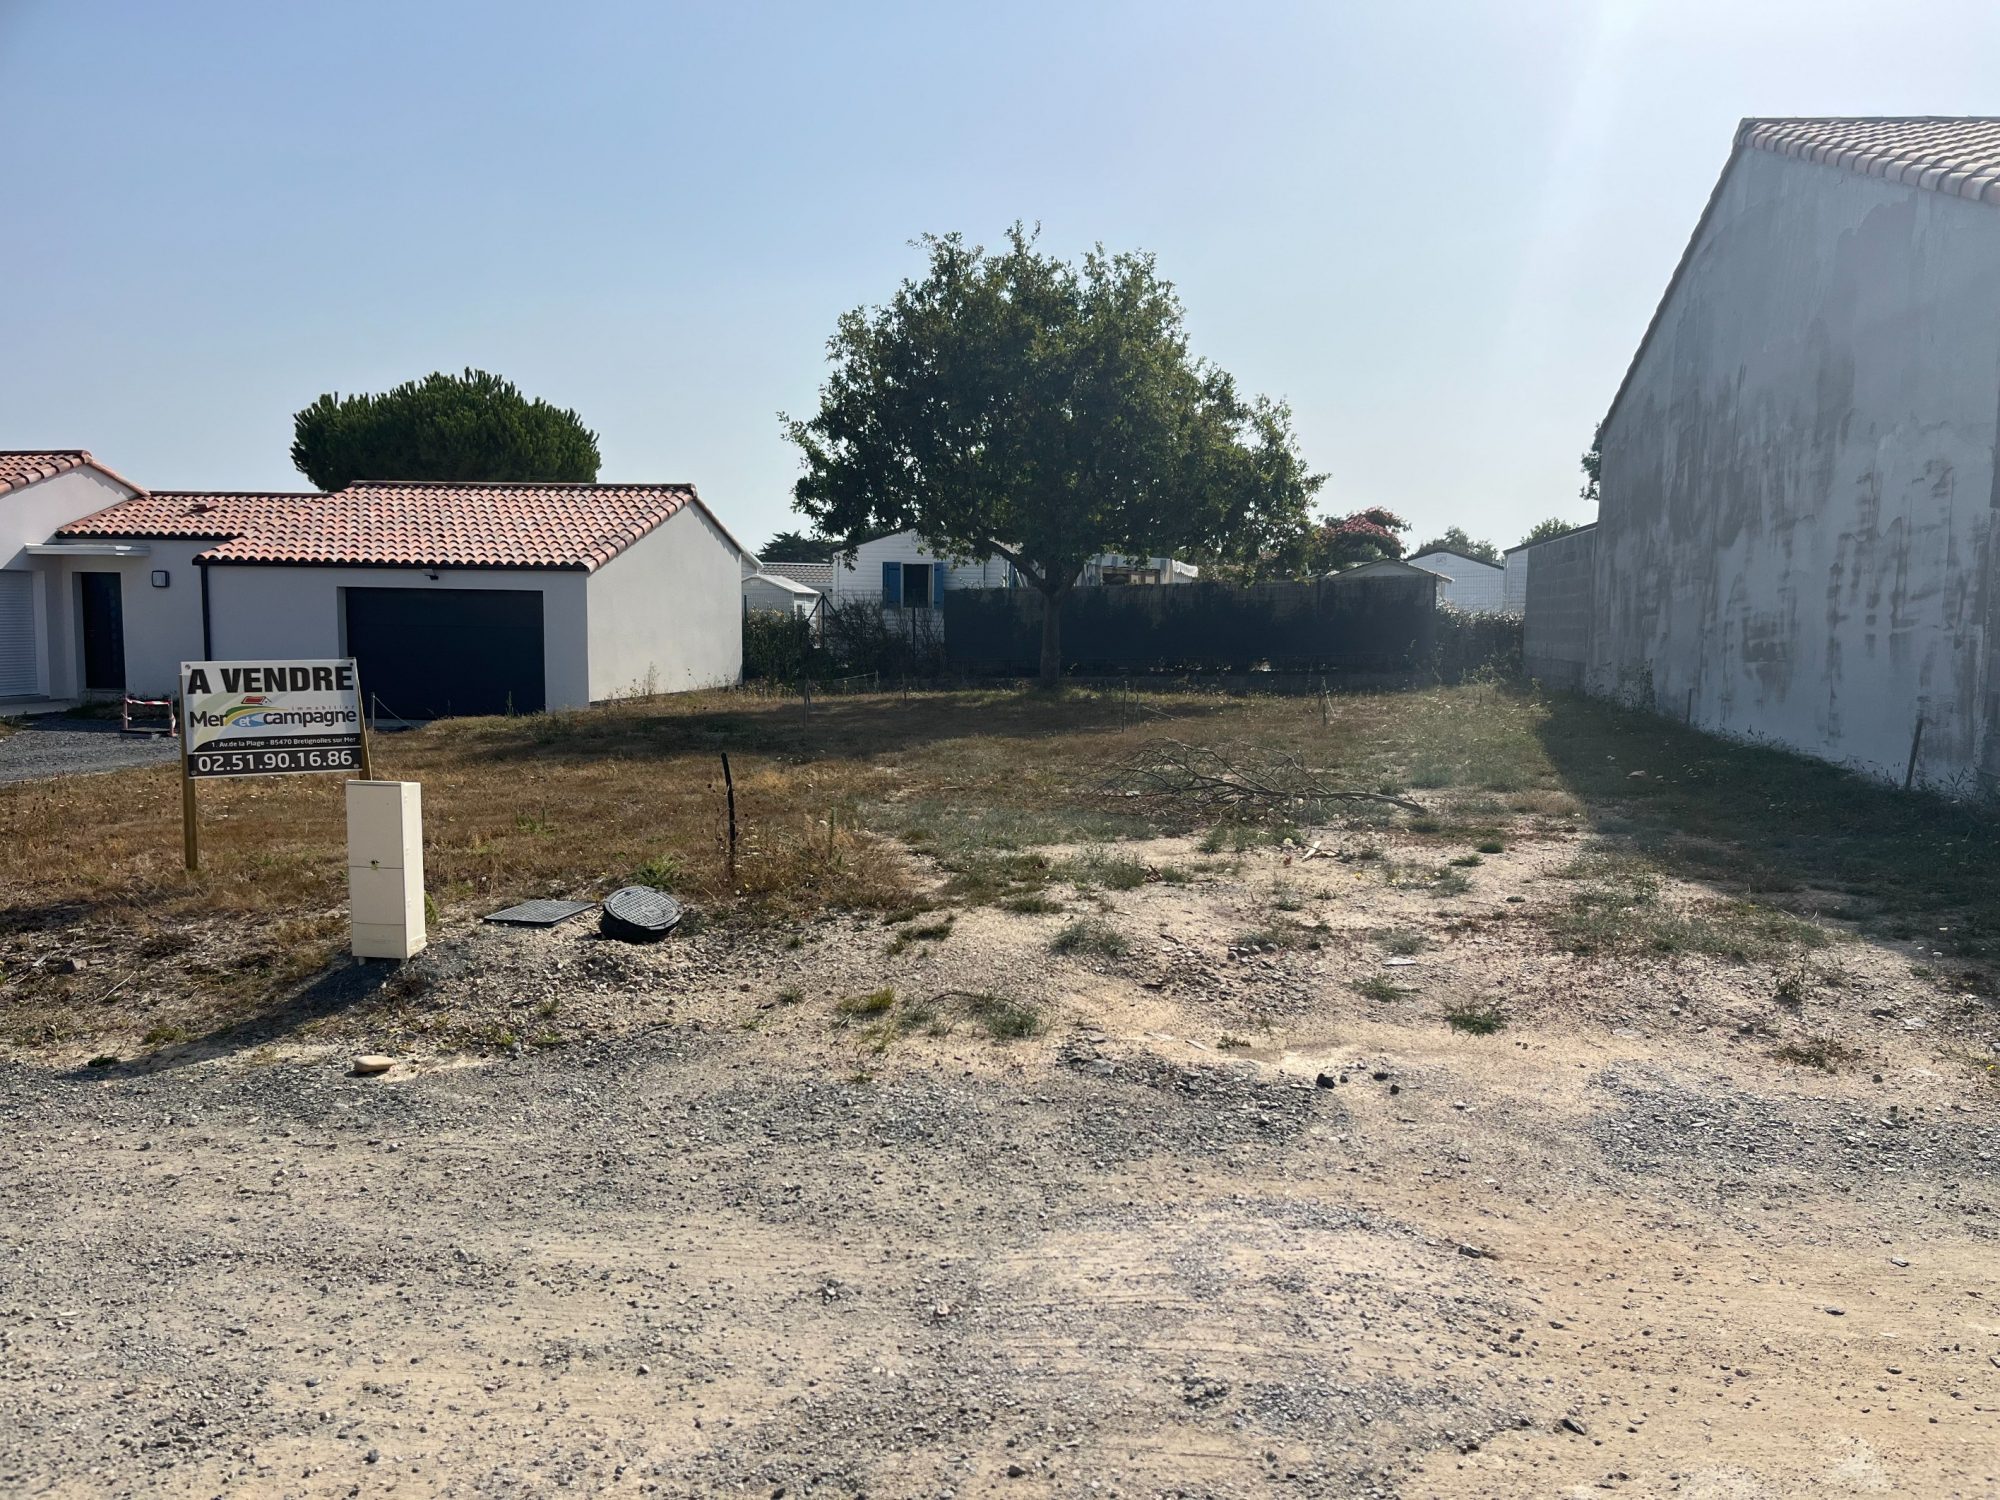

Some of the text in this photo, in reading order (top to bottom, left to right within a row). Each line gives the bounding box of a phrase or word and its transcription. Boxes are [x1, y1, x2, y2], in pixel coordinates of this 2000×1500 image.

[188, 667, 354, 694] A VENDRE
[189, 710, 356, 727] Mer et campagne
[198, 750, 353, 772] 02.51.90.16.86
